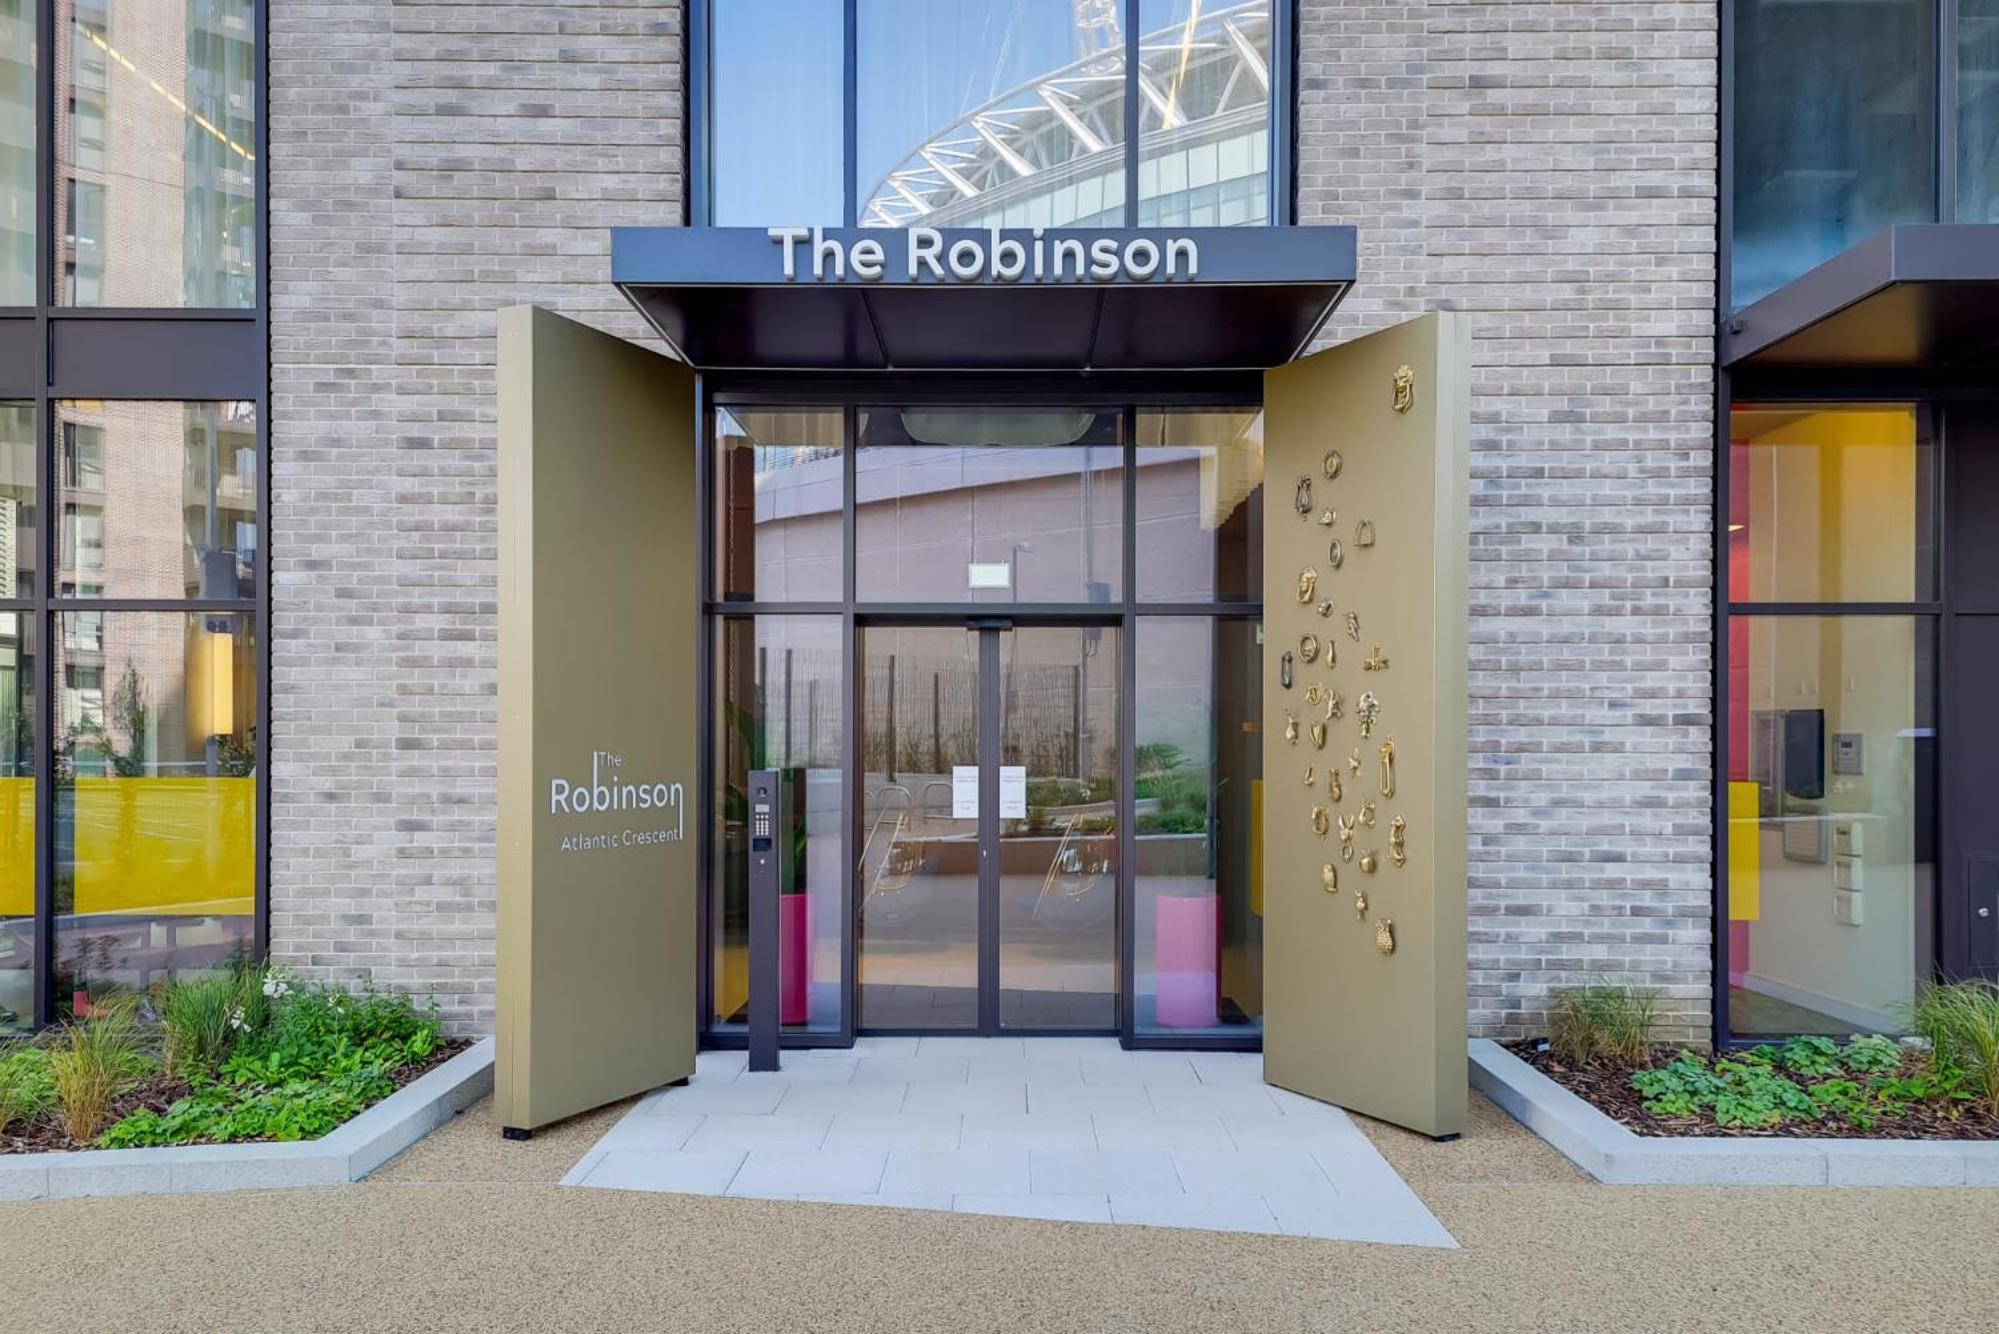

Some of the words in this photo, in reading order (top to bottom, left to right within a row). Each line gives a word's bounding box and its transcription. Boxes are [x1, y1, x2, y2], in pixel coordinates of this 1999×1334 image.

[768, 225, 886, 282] The
[907, 225, 1199, 283] Robinson
[599, 751, 622, 767] The
[551, 751, 683, 840] Robinson
[561, 832, 619, 851] Atlantic
[622, 828, 678, 846] Crescent
